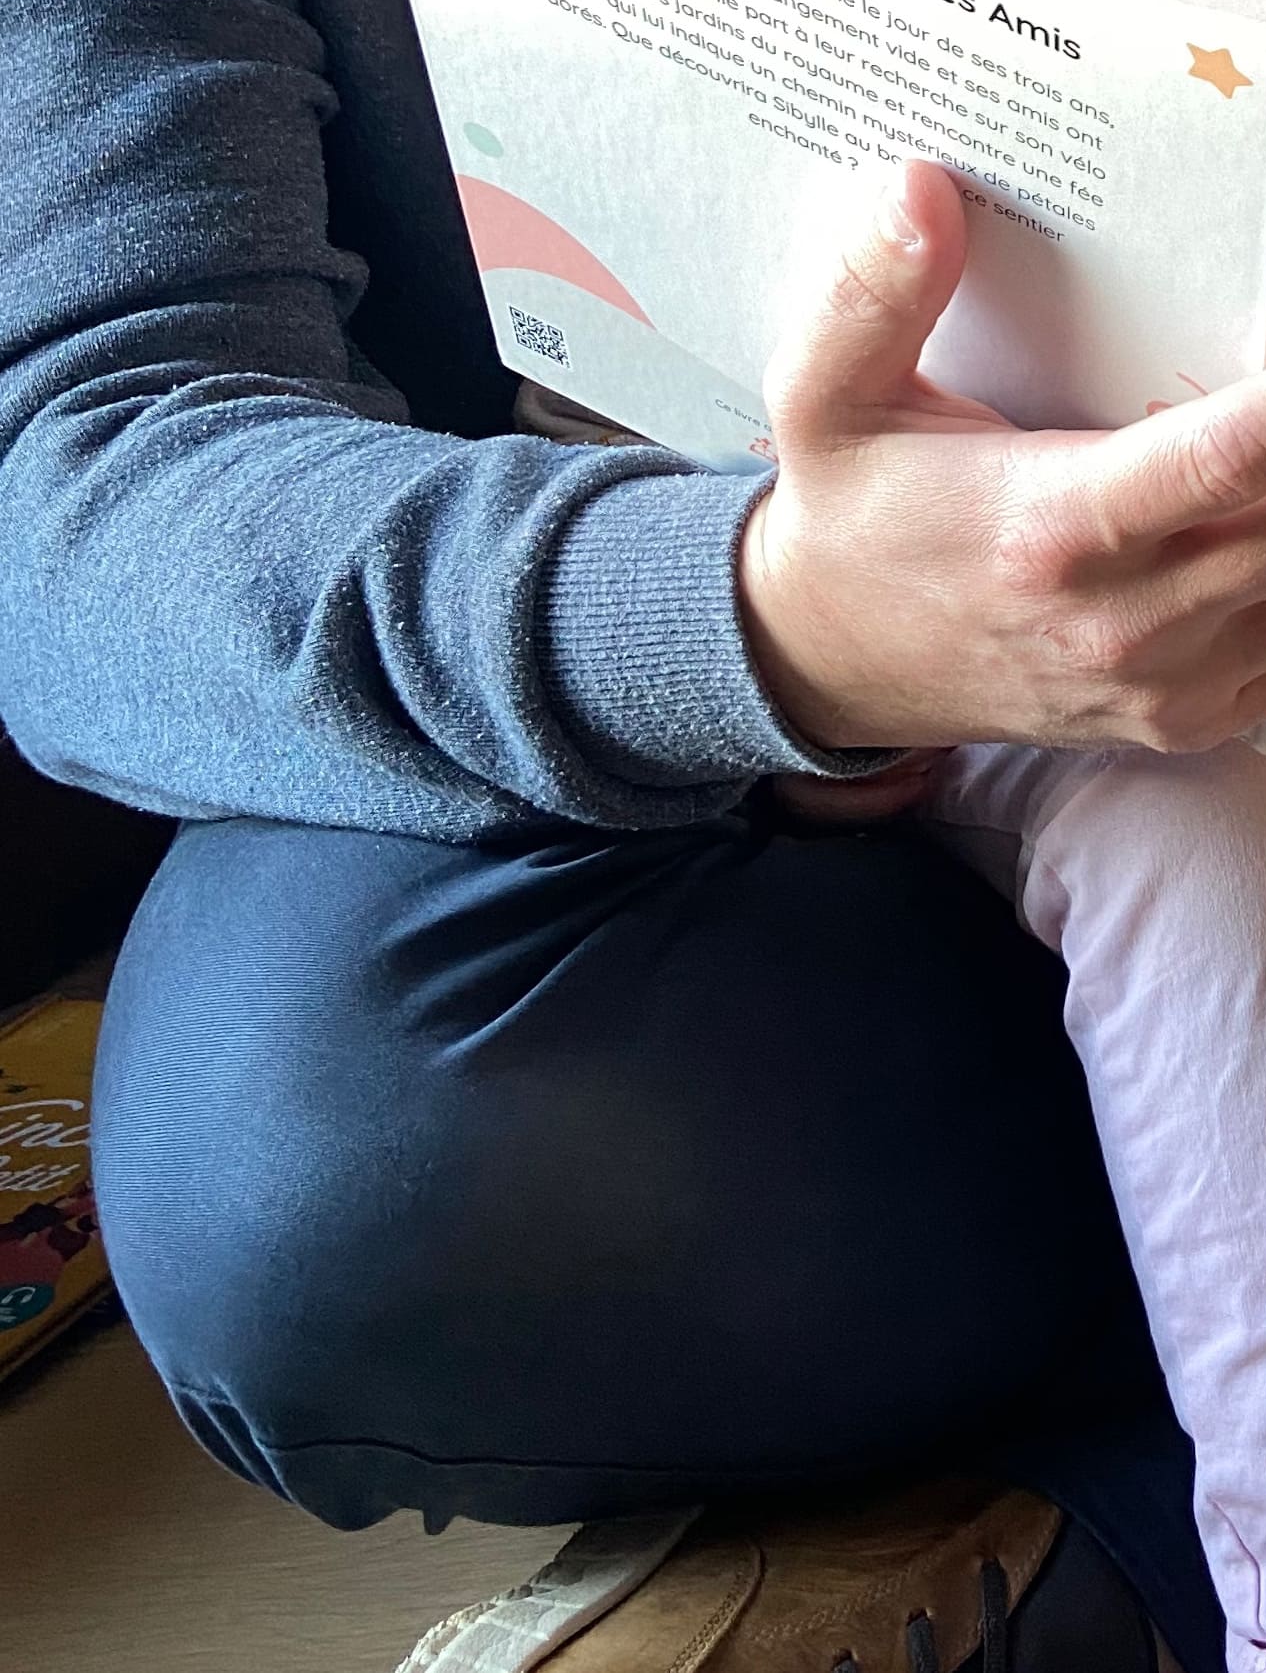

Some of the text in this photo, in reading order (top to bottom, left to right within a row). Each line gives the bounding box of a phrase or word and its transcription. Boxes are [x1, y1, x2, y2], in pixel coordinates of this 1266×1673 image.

[745, 5, 789, 34] part
[794, 26, 809, 43] à
[814, 34, 856, 63] leur
[861, 59, 968, 117] recherche
[975, 113, 1009, 134] sur
[1015, 131, 1053, 157] son
[1060, 151, 1106, 180] vélo
[885, 10, 931, 41] jour
[936, 37, 964, 59] de
[971, 53, 1007, 78] ses
[1013, 70, 1062, 103] trois
[885, 41, 931, 71] vide
[937, 67, 958, 85] et
[964, 79, 1000, 104] ses
[1006, 99, 1060, 131] amis
[1066, 126, 1103, 151] ont
[988, 2, 1081, 60] Amis
[611, 21, 653, 51] Que
[658, 45, 767, 104] découvrira
[772, 96, 839, 137] Sibylle
[845, 133, 871, 152] au
[994, 203, 1065, 242] sentier
[642, 7, 665, 30] lui
[669, 21, 745, 67] indique
[750, 61, 776, 82] un
[782, 77, 856, 120] chemin
[863, 114, 977, 177] mystérieux
[984, 172, 1010, 191] de
[1018, 187, 1095, 231] pétales
[748, 113, 859, 171] enchanté ?
[751, 35, 777, 55] du
[783, 50, 879, 103] royaume
[884, 98, 905, 116] et
[911, 110, 1016, 166] rencontre
[1022, 161, 1062, 188] une
[1069, 180, 1104, 207] fée
